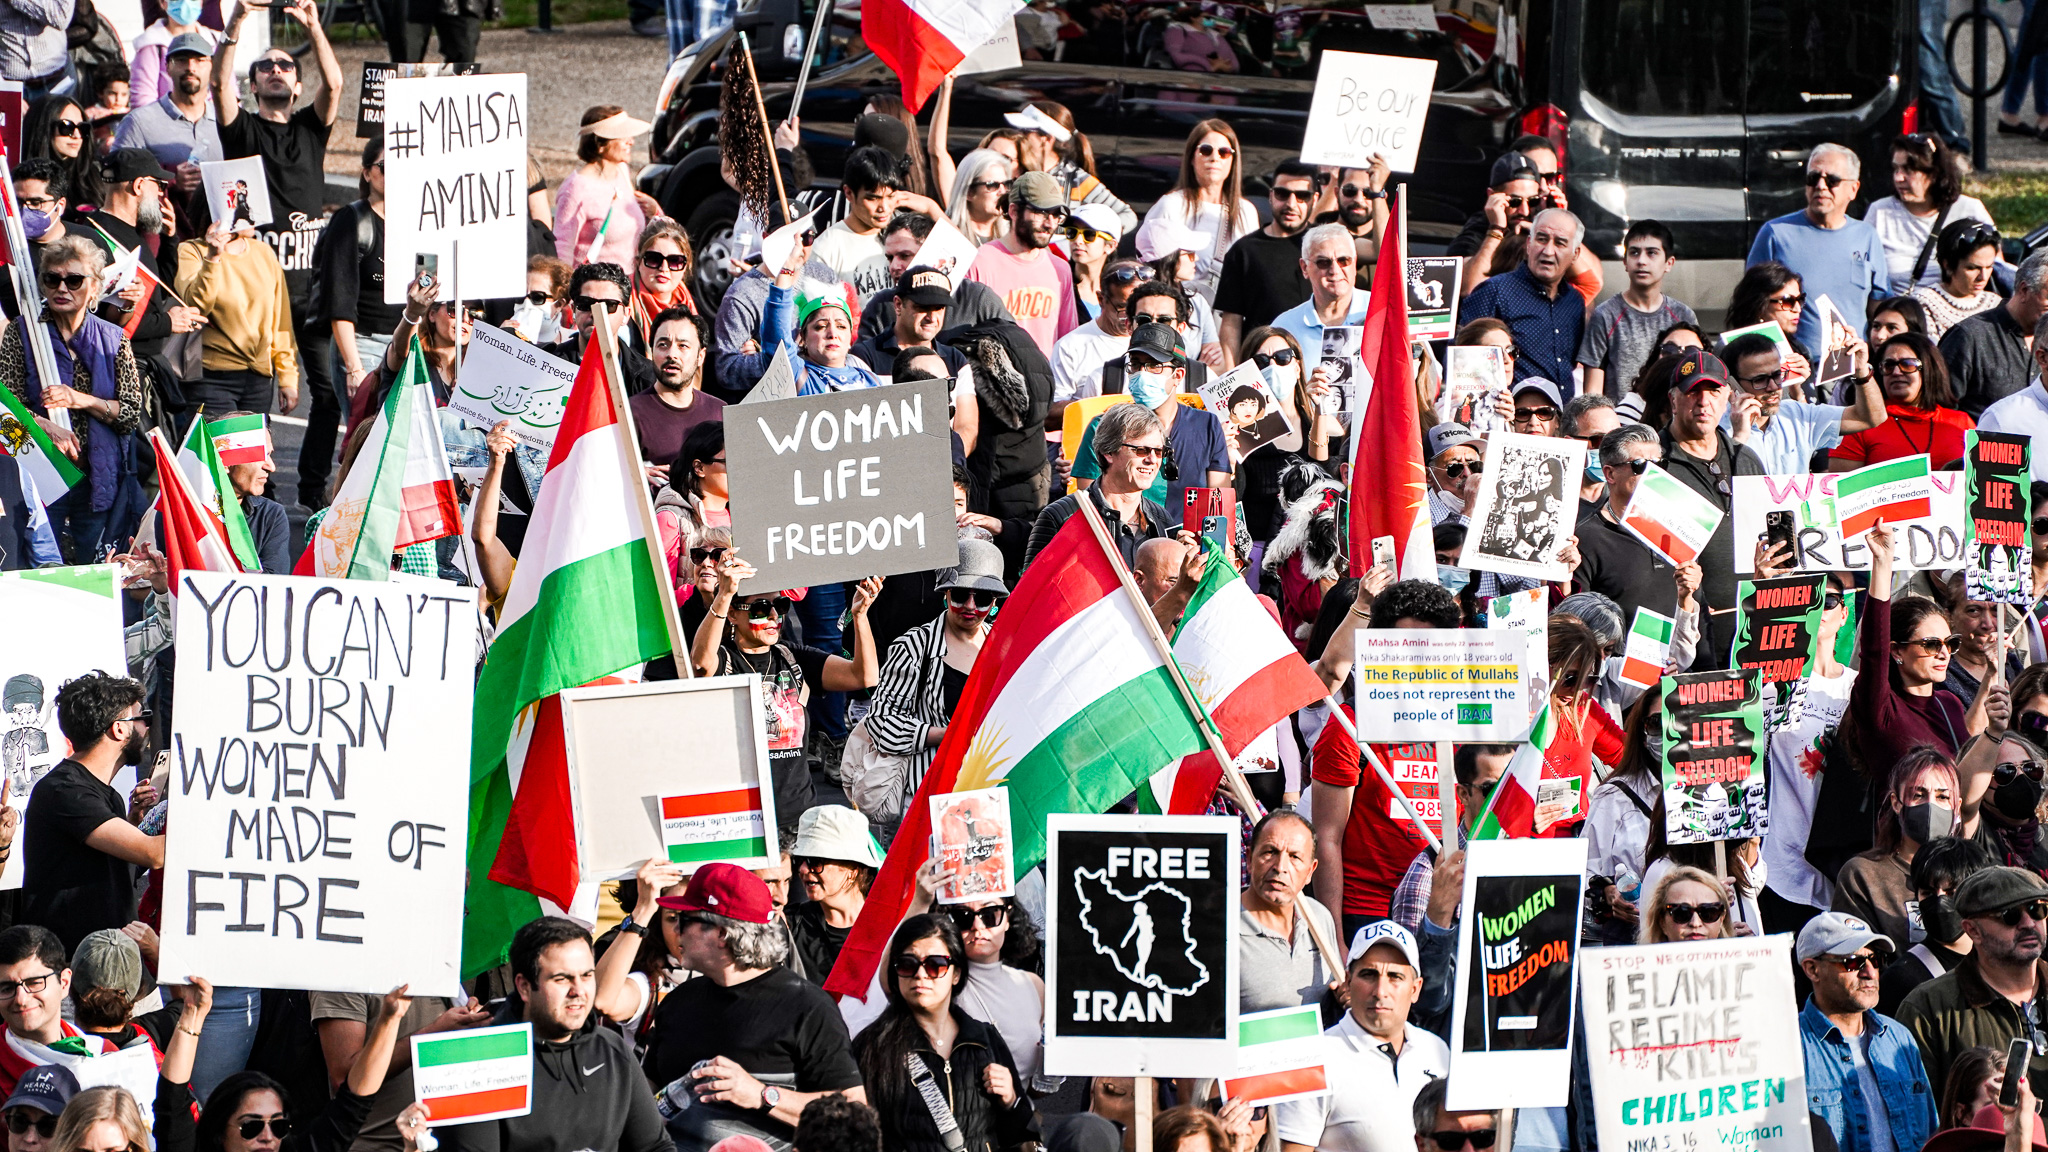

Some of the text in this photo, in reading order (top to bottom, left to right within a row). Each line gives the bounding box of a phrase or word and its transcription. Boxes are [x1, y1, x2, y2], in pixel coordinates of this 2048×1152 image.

[365, 68, 397, 81] STAND
[1337, 77, 1368, 116] Be
[389, 91, 522, 159] #MAHSA
[1344, 123, 1407, 149] voice
[419, 169, 515, 231] AMINI
[474, 328, 577, 383] Woman. Life. Freed
[1207, 375, 1236, 395] WOMAN
[1216, 385, 1233, 399] LIFE
[450, 401, 477, 418] Justice
[757, 393, 923, 455] WOMAN
[1979, 440, 2022, 465] WOMEN
[794, 456, 881, 506] LIFE
[1891, 488, 1930, 500] Freedom
[1985, 481, 2014, 510] LIFE
[767, 512, 926, 564] FREEDOM
[1974, 518, 2025, 548] FREEDOM
[1756, 585, 1812, 609] WOMEN
[184, 576, 470, 681] YOU CAN'T
[1508, 619, 1526, 629] STAND
[1759, 623, 1798, 651] LIFE
[1368, 638, 1400, 647] Mahsa
[1402, 638, 1430, 647] Amini
[1361, 653, 1379, 662] Nika
[1443, 653, 1460, 663] only
[1463, 653, 1473, 661] 18
[1475, 654, 1497, 663] years
[1499, 653, 1513, 662] old
[1365, 669, 1519, 682] The Republic of Mullahs
[1369, 688, 1515, 702] does not represent the
[1678, 679, 1745, 706] WOMEN
[247, 674, 394, 751] BURN
[1393, 708, 1492, 723] people of IRAN
[1692, 719, 1735, 749] LIFE
[175, 733, 346, 802] WOMEN
[1675, 755, 1752, 787] FREEDOM
[225, 806, 446, 870] MADE OF
[665, 819, 706, 830] Freedom
[1108, 847, 1210, 879] FREE
[187, 869, 365, 945] FIRE
[1483, 884, 1555, 941] WOMEN
[1363, 923, 1408, 945] USA
[1485, 936, 1522, 970] LIFE
[1603, 948, 1772, 970] STOP NEGOTIATING WITH
[1487, 940, 1569, 997] FREEDOM
[1607, 962, 1756, 1014] ISLAMIC
[1073, 990, 1172, 1023] IRAN
[1609, 1006, 1741, 1053] REGIME
[1657, 1040, 1761, 1082] KILLS
[24, 1082, 56, 1092] HEARST
[487, 1074, 528, 1086] Freedom
[1622, 1077, 1786, 1126] CHILDREN
[1682, 1131, 1697, 1146] 16
[1717, 1124, 1783, 1146] Woman
